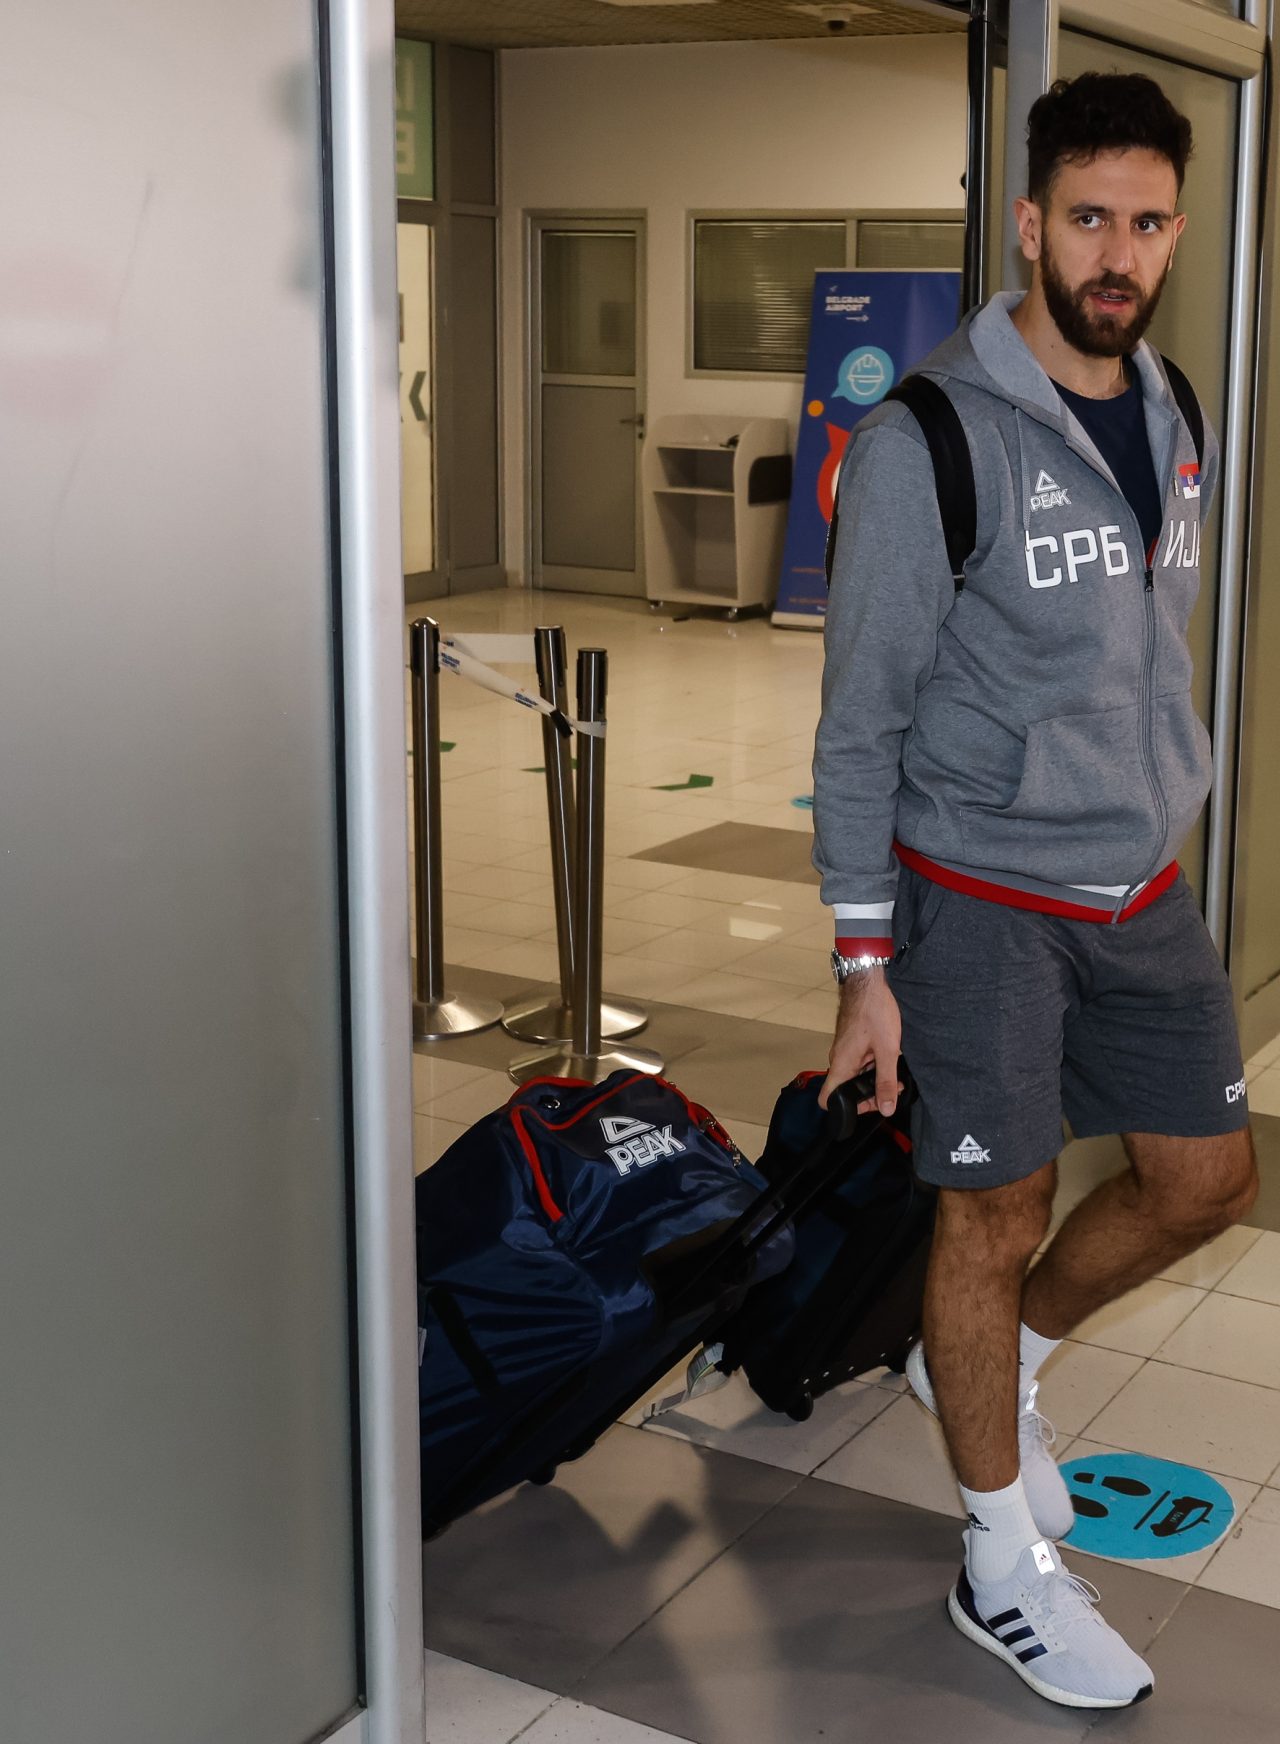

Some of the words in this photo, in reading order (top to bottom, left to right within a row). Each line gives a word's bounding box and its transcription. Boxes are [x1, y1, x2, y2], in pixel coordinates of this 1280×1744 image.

[1030, 488, 1072, 512] PEAK
[1025, 525, 1130, 589] СРБ
[604, 1124, 687, 1176] PEAK
[950, 1149, 992, 1164] PEAK
